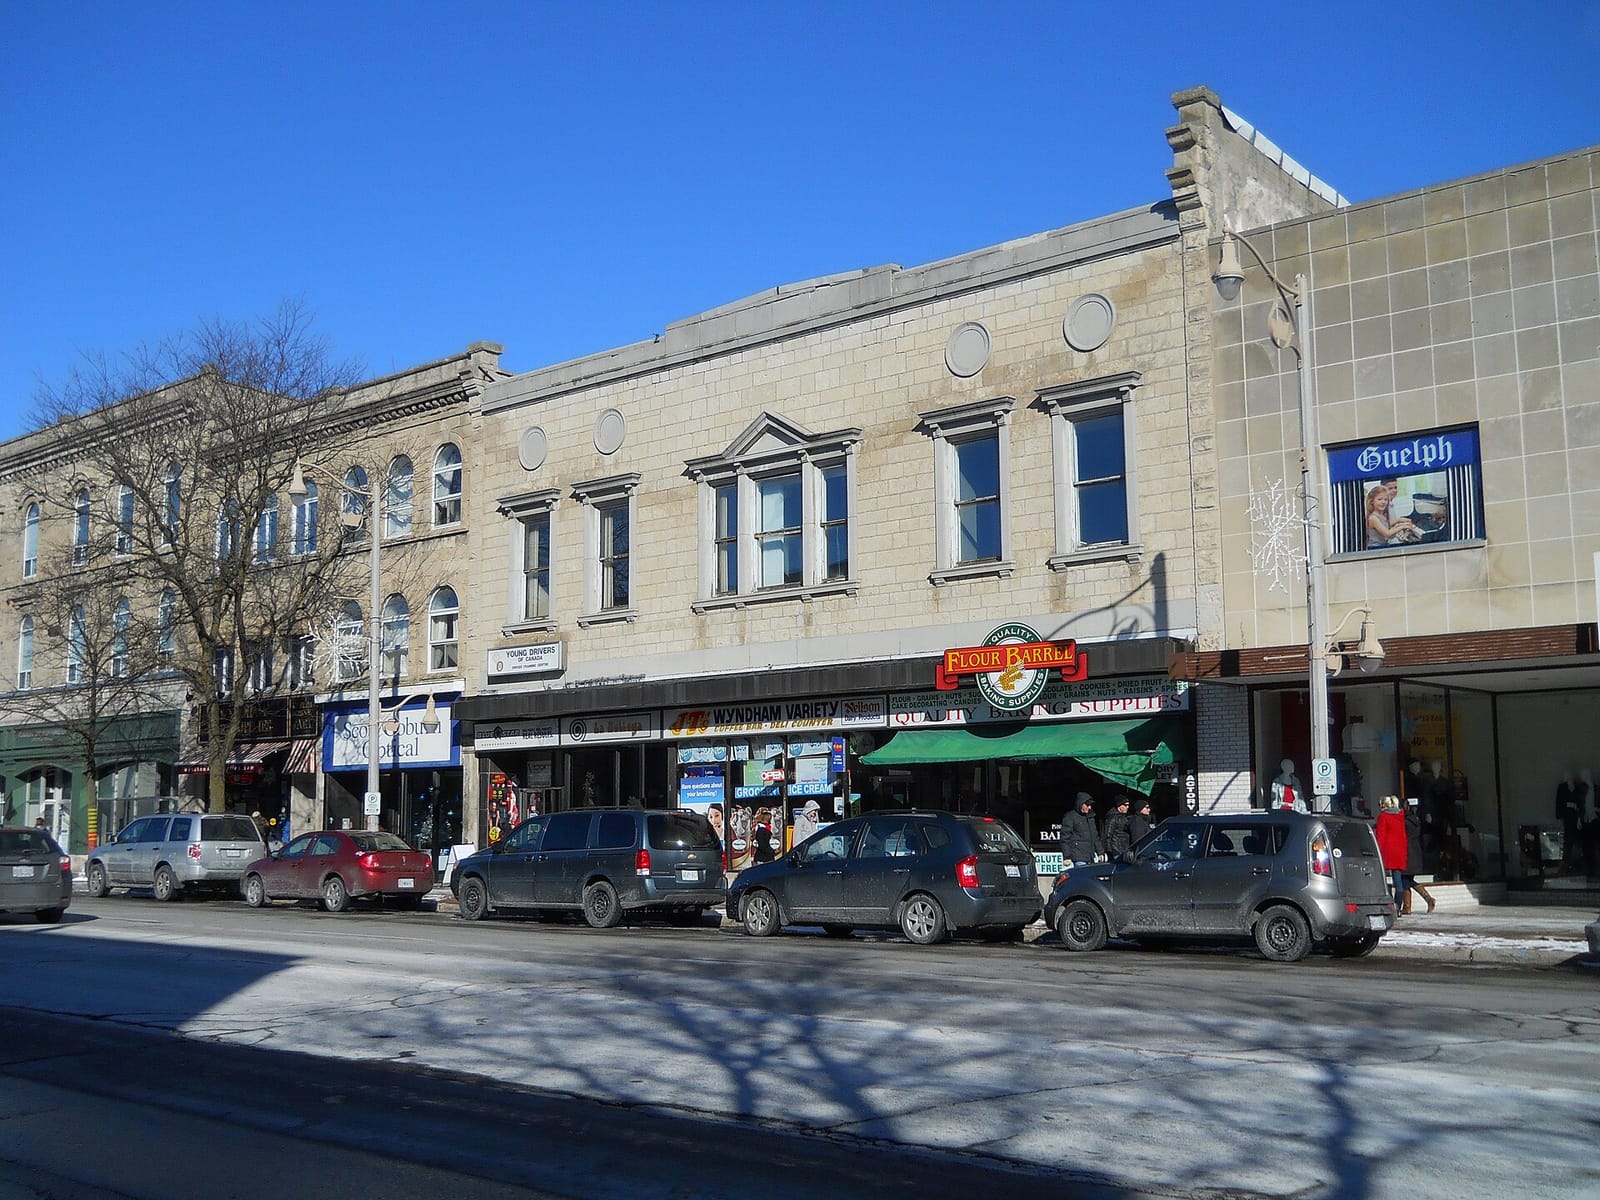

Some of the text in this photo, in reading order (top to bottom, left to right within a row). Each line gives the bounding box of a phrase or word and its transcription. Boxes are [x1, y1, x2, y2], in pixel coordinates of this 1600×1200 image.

[1356, 436, 1453, 472] Guelph
[991, 628, 1033, 642] QUALITY
[506, 646, 556, 658] YOUNG DRIVERS
[946, 645, 1073, 672] FLOUR BARREL
[980, 673, 1044, 706] BAKING SUPPLIES
[1079, 682, 1111, 691] COOKIES
[1118, 680, 1139, 688] DRIED
[1141, 678, 1162, 686] FRUIT
[945, 692, 961, 700] NUTS
[1039, 683, 1188, 700] LOUR GRAINS NUTS RAISINS SPICES
[845, 701, 880, 713] Neilson
[909, 700, 947, 708] DECORATING
[954, 698, 981, 706] CANDIES
[713, 701, 839, 724] WYNDHAM VARIETY
[895, 707, 977, 726] QUALITY
[1079, 694, 1181, 714] SUPPLIES
[714, 717, 834, 733] COFFEE BAR DELI COUNTER
[789, 783, 833, 794] ICE CREAM
[1035, 854, 1062, 864] GLUTE
[1041, 864, 1062, 873] FREE
